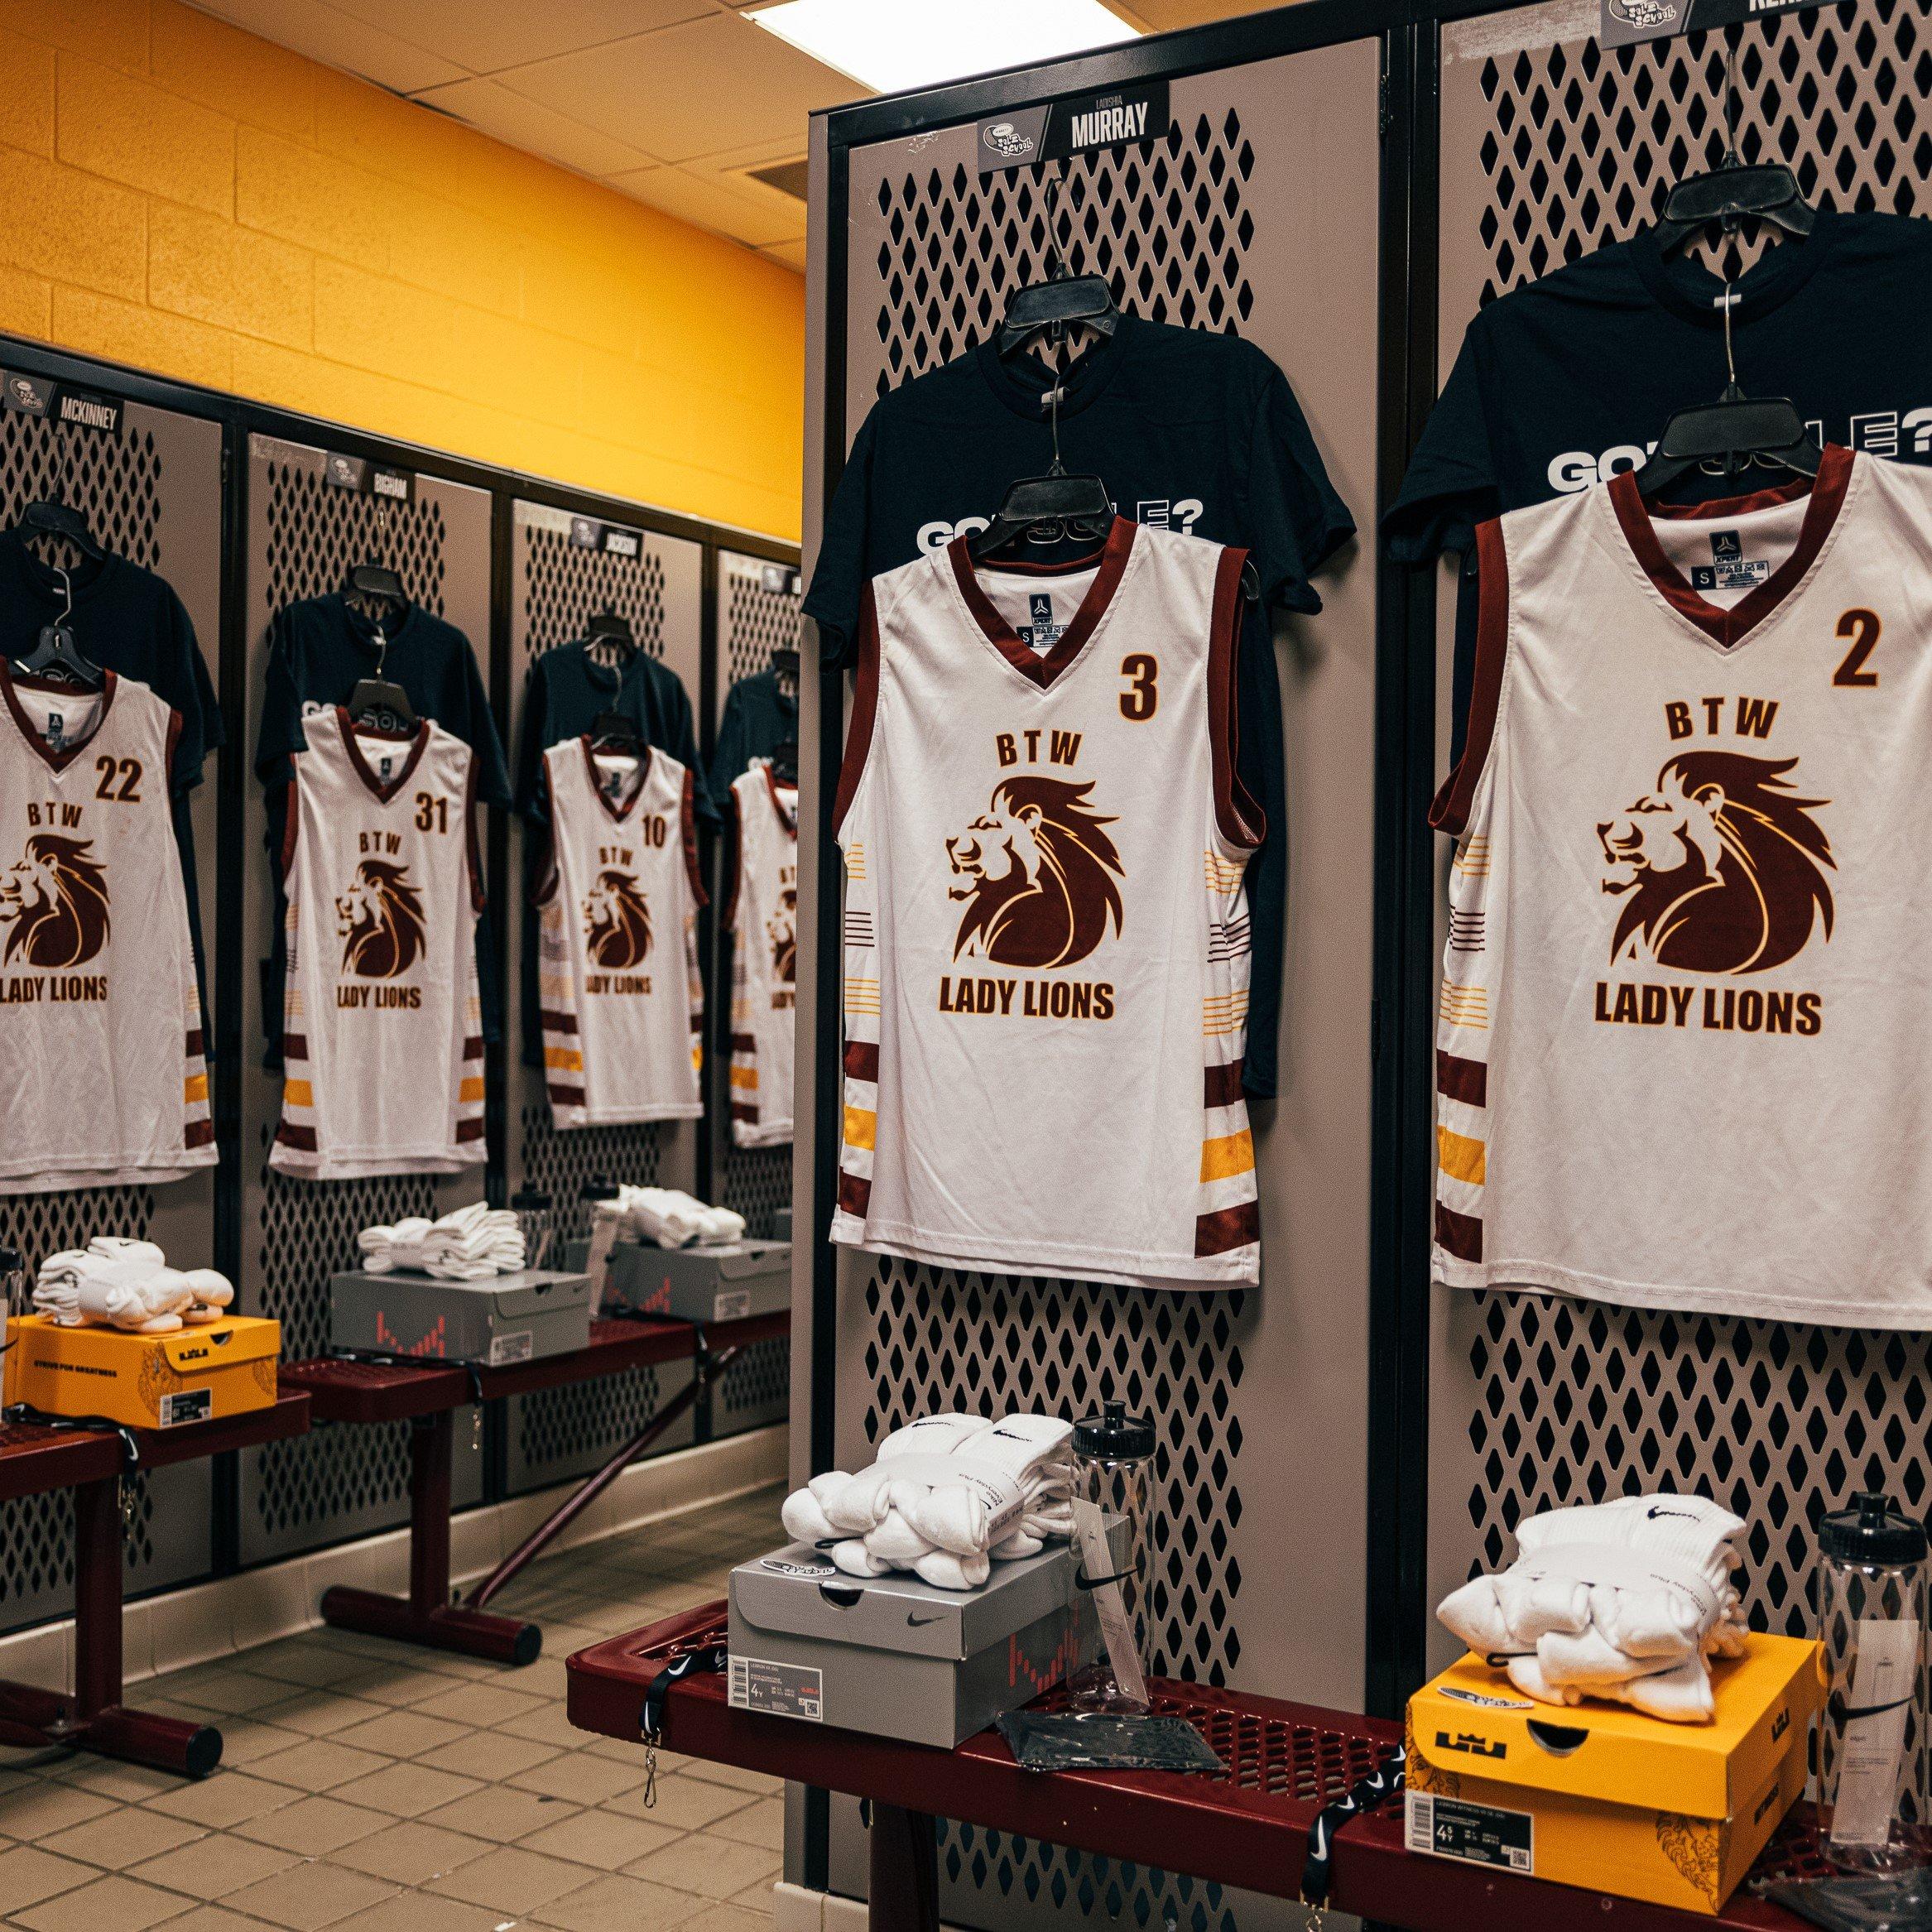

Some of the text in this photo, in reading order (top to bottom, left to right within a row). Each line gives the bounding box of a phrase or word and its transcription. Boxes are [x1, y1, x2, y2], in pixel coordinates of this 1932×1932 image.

[1071, 102, 1148, 148] MURRAY
[60, 396, 117, 430] MCKINNEY
[1547, 440, 1658, 493] GO
[916, 514, 996, 557] GO
[1699, 572, 1710, 584] S
[1022, 632, 1030, 642] S
[1831, 608, 1882, 689] 2
[1119, 652, 1159, 723] 3
[1665, 695, 1781, 741] BTW
[996, 728, 1084, 767] BTW
[95, 755, 143, 803] 22
[27, 800, 83, 829] BTW
[416, 791, 447, 835] 31
[642, 815, 666, 849] 10
[0, 975, 108, 1003] LADY LIONS
[337, 985, 422, 1010] LADY LIONS
[938, 976, 1115, 1021] LADY LIONS
[1594, 981, 1823, 1036] LADY LIONS
